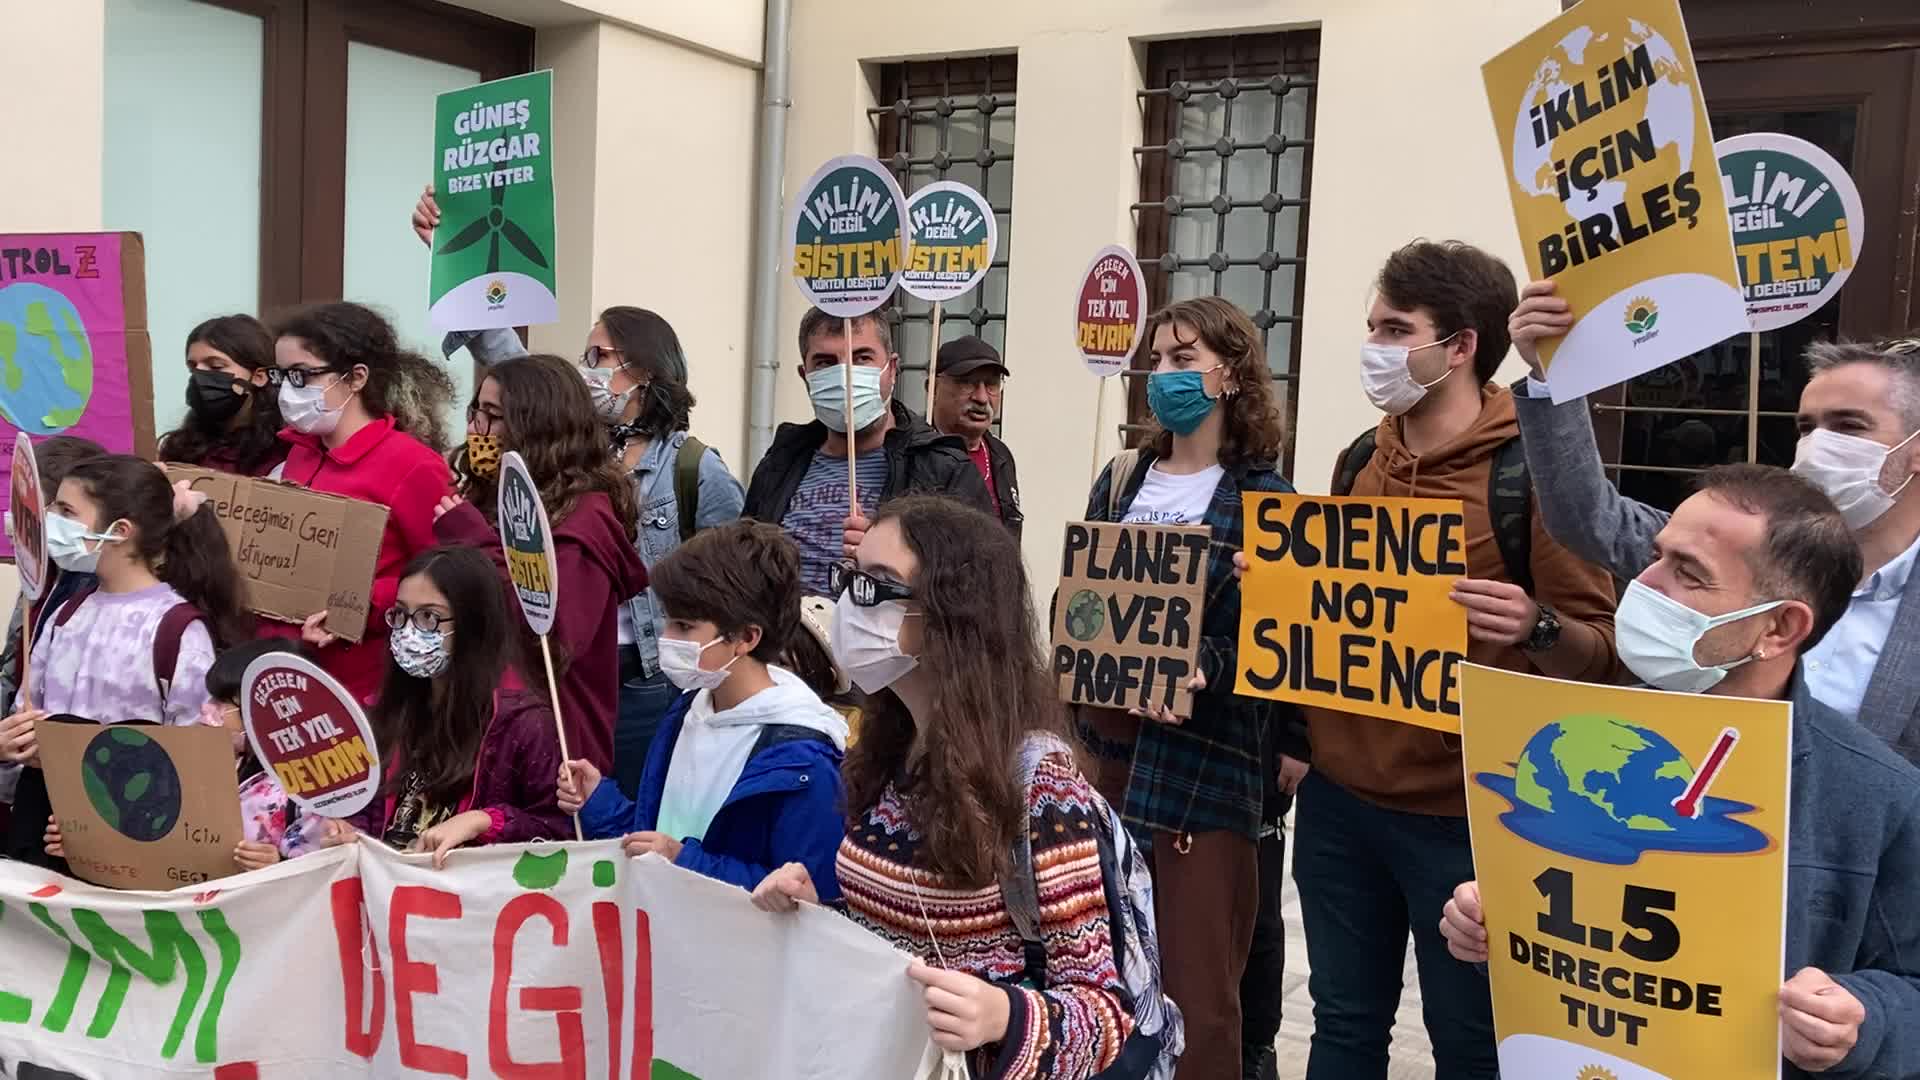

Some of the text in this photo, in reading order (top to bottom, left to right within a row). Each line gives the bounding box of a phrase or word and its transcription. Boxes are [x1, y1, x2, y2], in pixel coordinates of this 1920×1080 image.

[454, 99, 531, 136] GÜNEŞ
[1529, 44, 1658, 150] İKLİM
[443, 132, 541, 171] RÜZGAR
[1553, 118, 1657, 203] İÇİN
[448, 165, 534, 194] BİZE YETER
[1721, 161, 1830, 219] LİMİ
[829, 211, 867, 234] DEĞİL
[925, 222, 958, 239] DEĞİL
[1538, 170, 1701, 281] BİRLEŞ
[1730, 204, 1784, 233] EĞİL
[75, 246, 100, 279] Z
[904, 238, 988, 272] İSTEMİ
[1094, 259, 1129, 280] GEZEGEN
[1736, 218, 1853, 286] TEMİ
[1087, 299, 1130, 319] TEK YOL
[1077, 319, 1136, 352] DEVRİM
[299, 512, 340, 549] Geri
[1255, 497, 1467, 576] SCIENCE
[1063, 525, 1209, 585] PLANET
[1311, 580, 1408, 633] NOT
[1055, 644, 1189, 711] PROFIT
[1245, 618, 1466, 716] SILENCE
[254, 672, 308, 708] GEZEGEN
[270, 694, 303, 723] İÇİN
[268, 713, 345, 755] TEK YOL
[273, 735, 378, 796] DEVRİM
[1533, 867, 1681, 963] 1.5
[1509, 931, 1723, 1016] DERECEDE
[1560, 993, 1648, 1046] TUT
